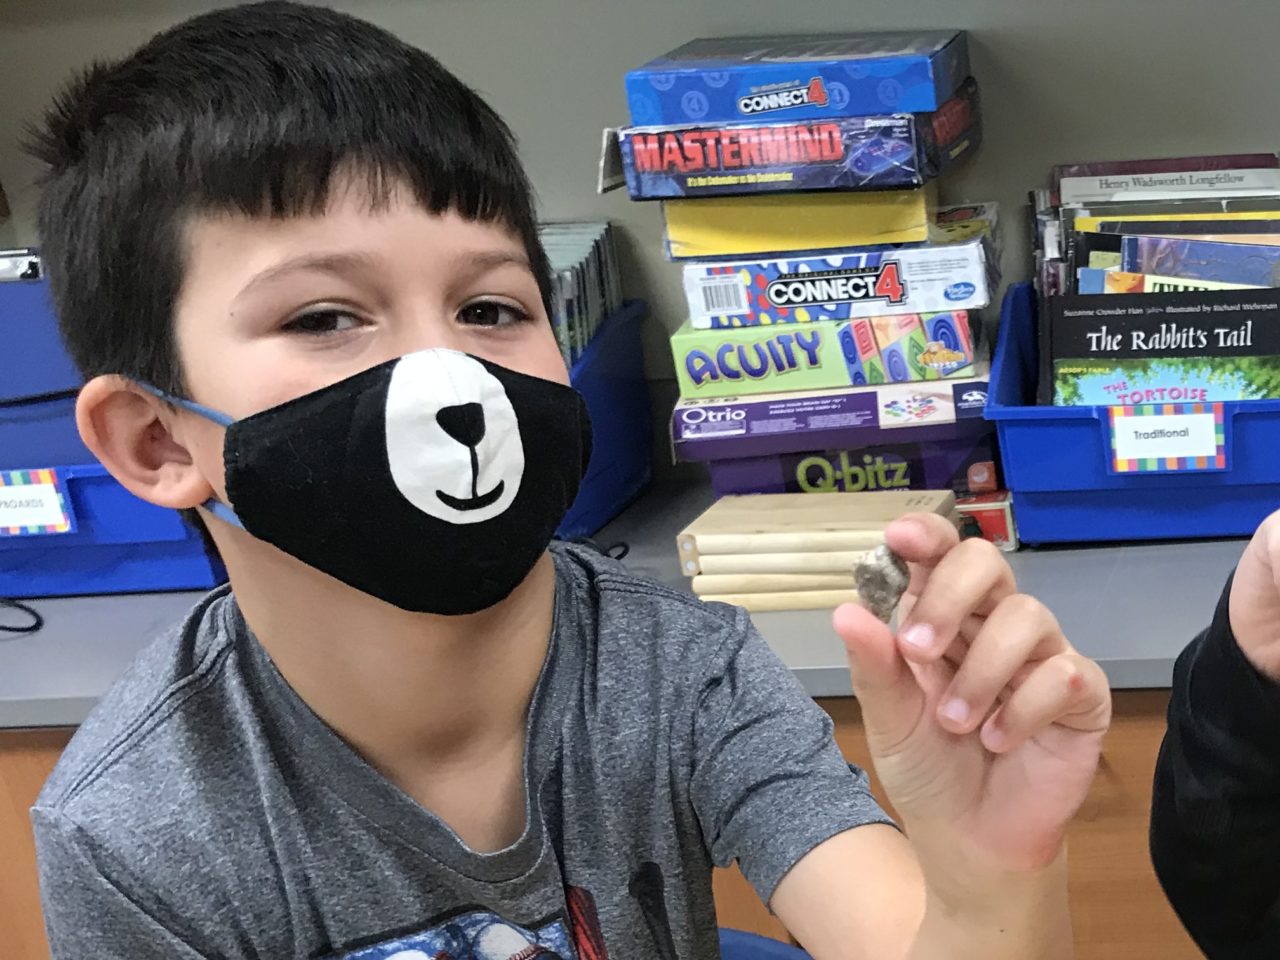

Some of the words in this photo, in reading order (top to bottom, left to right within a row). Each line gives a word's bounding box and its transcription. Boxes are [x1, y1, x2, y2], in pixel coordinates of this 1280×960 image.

[741, 89, 809, 113] CONNECT
[808, 78, 826, 105] 4
[631, 123, 845, 173] MASTERMIND
[1099, 178, 1129, 191] Henry
[1132, 175, 1187, 187] Wadsworth
[1189, 173, 1245, 187] Longfellow
[769, 276, 877, 304] CONNECT
[874, 264, 904, 302] 4
[1202, 303, 1212, 314] by
[1086, 325, 1123, 351] The
[1130, 322, 1208, 350] Rabbit's
[1214, 320, 1253, 347] Tail
[684, 329, 822, 386] ACUITY
[1103, 381, 1129, 395] THE
[1116, 387, 1209, 405] TORTOISE
[682, 408, 746, 424] Otrio
[1133, 427, 1190, 440] Traditional
